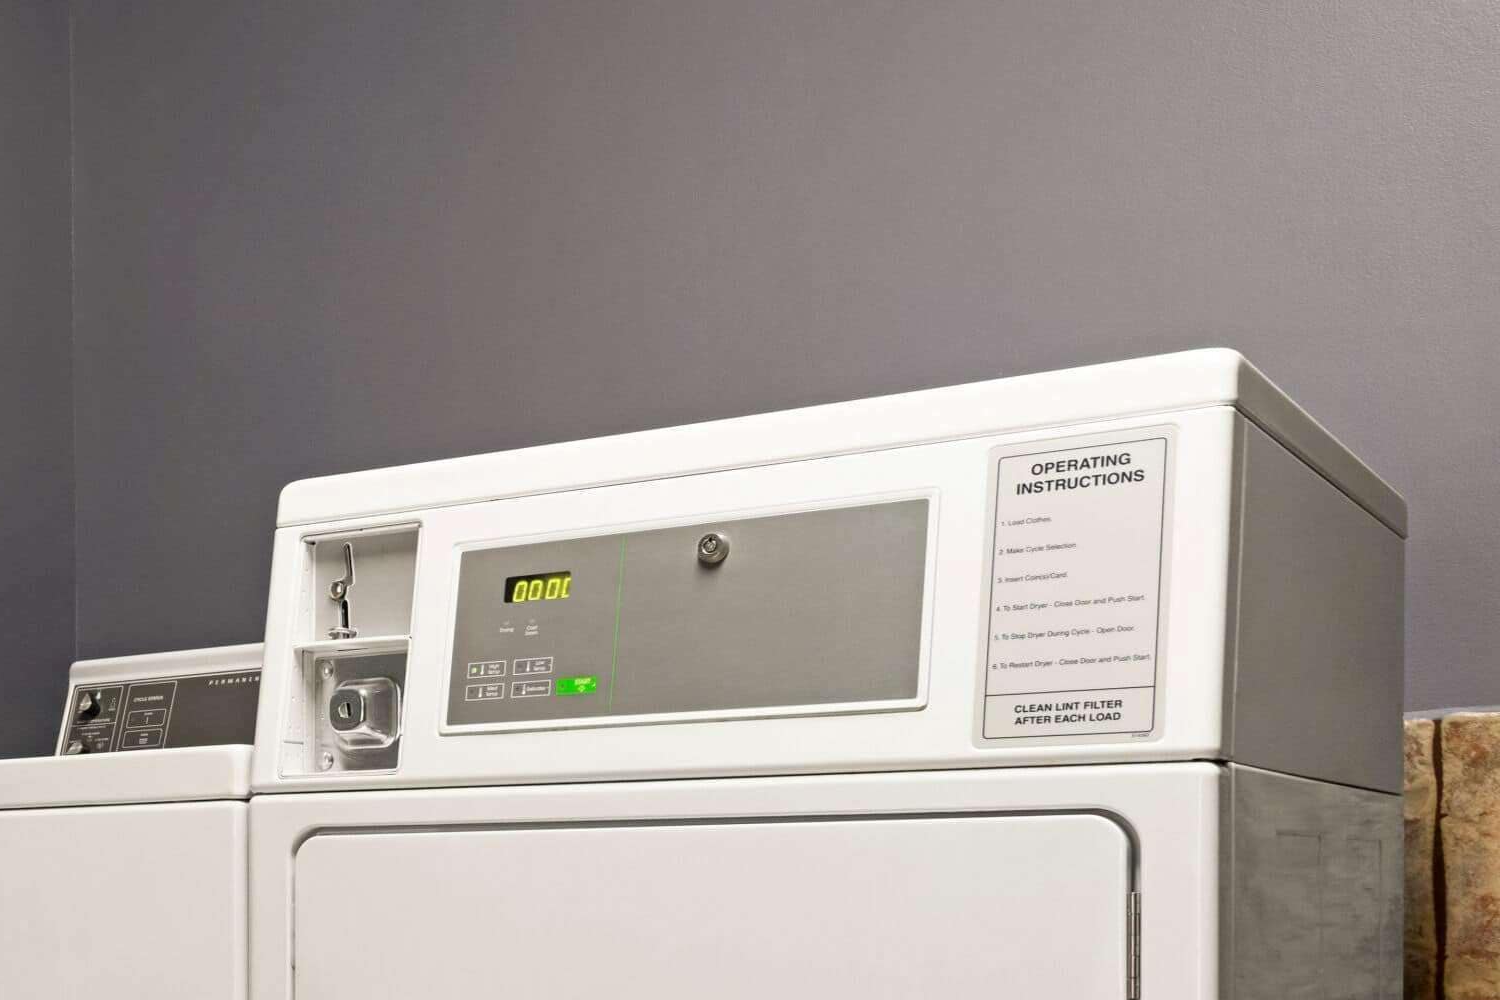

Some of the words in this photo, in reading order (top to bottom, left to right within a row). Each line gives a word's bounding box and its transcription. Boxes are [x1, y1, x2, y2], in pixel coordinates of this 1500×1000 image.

[1031, 452, 1132, 476] OPERATING
[1016, 469, 1146, 496] INSTRUCTIONS
[1008, 518, 1025, 527] Load
[1006, 547, 1024, 555] Make
[1026, 545, 1045, 554] Cycle
[1005, 575, 1024, 583] Insert
[1029, 603, 1048, 611] Dryer
[1054, 600, 1073, 608] Close
[1093, 597, 1106, 605] and
[1107, 596, 1126, 604] Push
[1010, 632, 1026, 641] Stop
[1027, 631, 1045, 640] Dryer
[1047, 630, 1070, 638] During
[1071, 628, 1090, 637] Cycle
[1096, 626, 1115, 635] Open
[1009, 661, 1033, 669] Restart
[1034, 660, 1053, 668] Dryer
[1059, 658, 1079, 666] Close
[1013, 701, 1053, 714] CLEAN
[1055, 700, 1081, 712] LINT
[1083, 698, 1123, 711] FILTER
[1013, 713, 1052, 726] AFTER
[1053, 712, 1086, 724] EACH
[1089, 711, 1122, 722] LOAD
